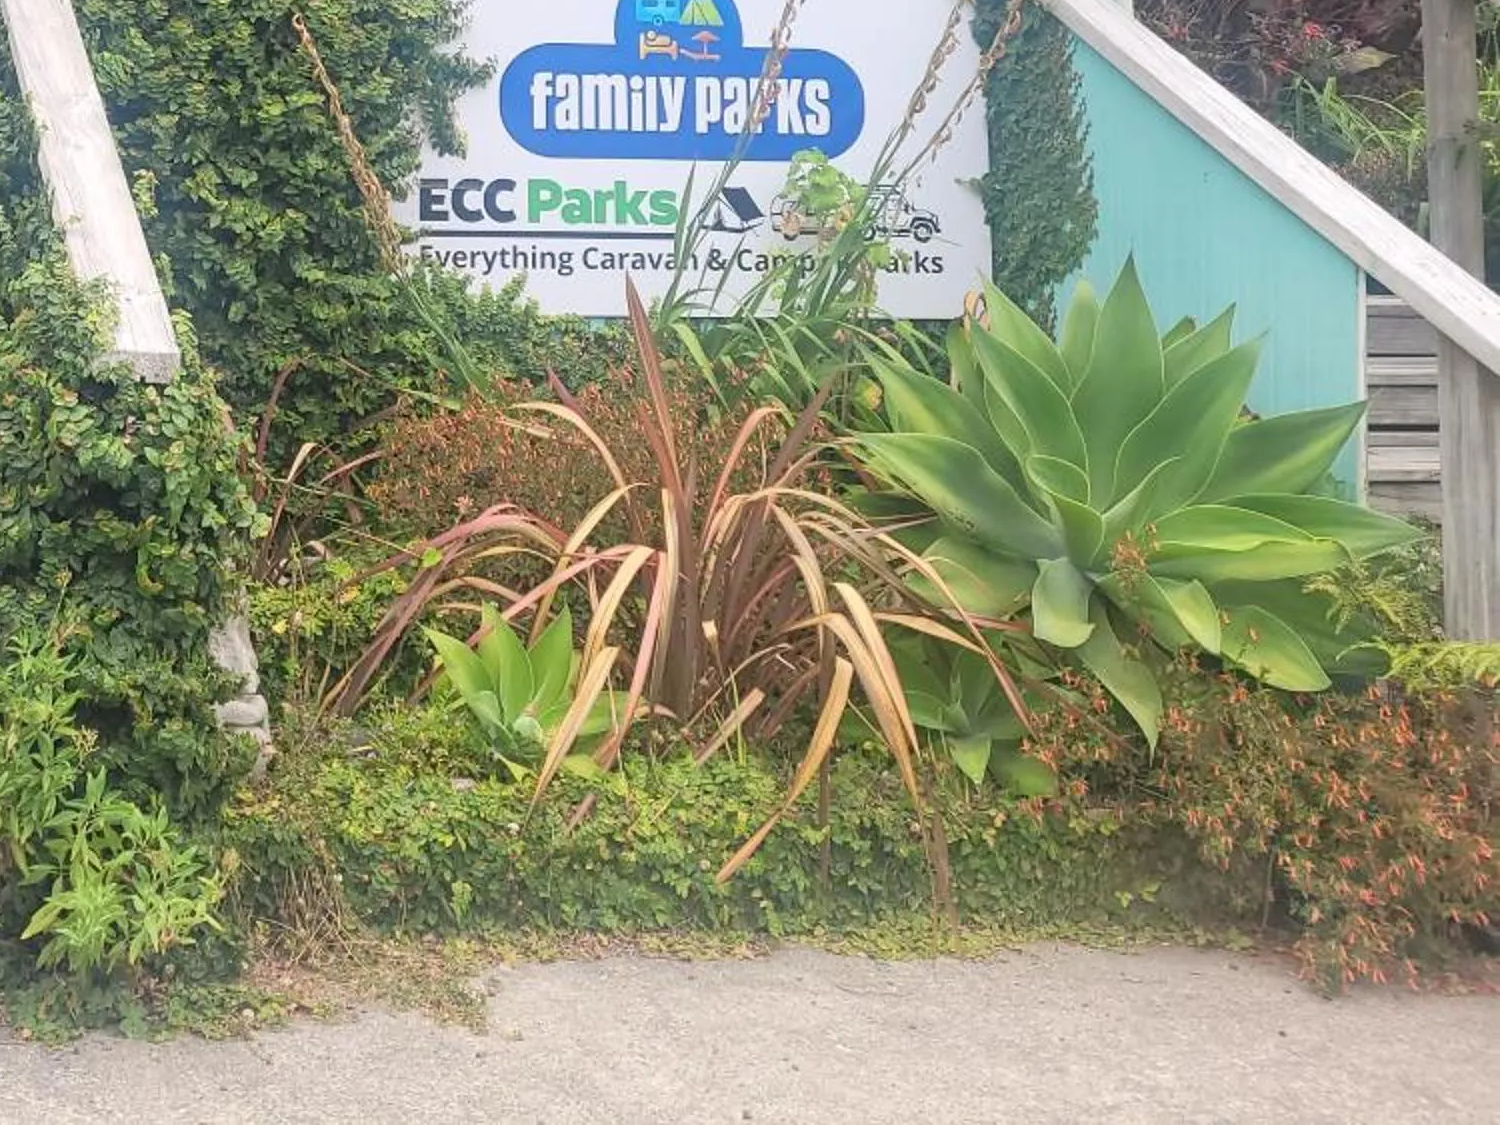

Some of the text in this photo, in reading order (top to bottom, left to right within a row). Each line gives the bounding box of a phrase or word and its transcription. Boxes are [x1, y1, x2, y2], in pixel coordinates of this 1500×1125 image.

[530, 72, 687, 133] family
[419, 177, 679, 226] ECC Parks
[420, 244, 575, 277] Everything
[708, 248, 728, 272] &
[872, 250, 944, 273] arks
